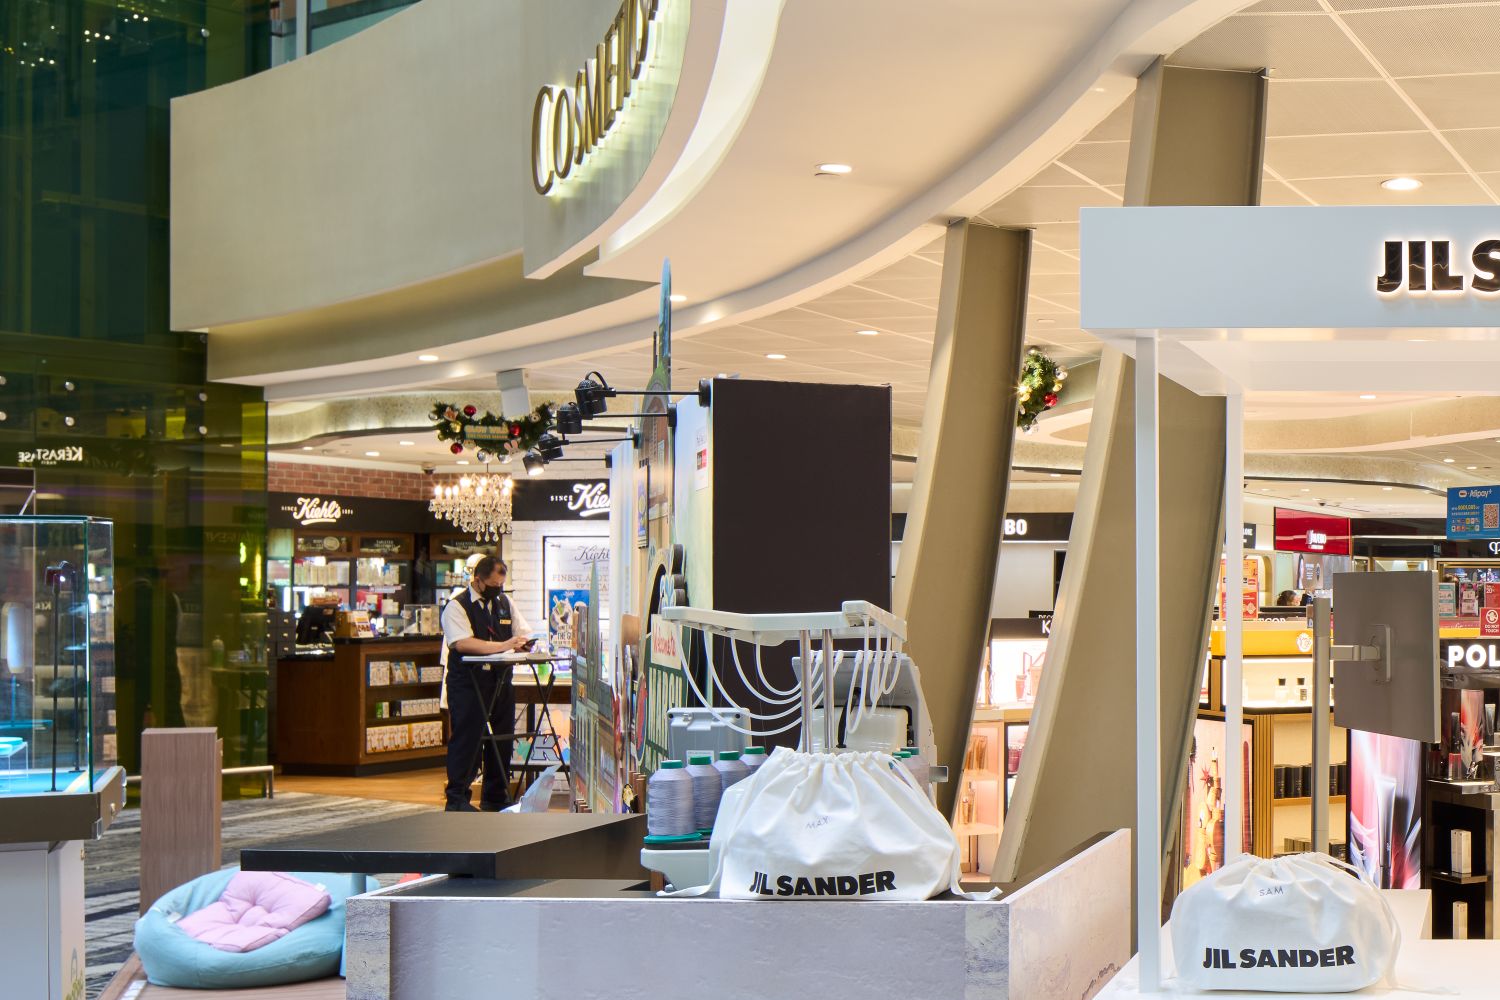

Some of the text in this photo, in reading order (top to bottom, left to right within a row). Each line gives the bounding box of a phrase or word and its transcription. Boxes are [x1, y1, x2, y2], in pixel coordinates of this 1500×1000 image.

[1377, 239, 1464, 293] JIL
[568, 482, 610, 511] Kie
[1004, 518, 1028, 536] BO
[748, 870, 897, 897] JIL SANDER
[1259, 885, 1285, 897] SAM
[1202, 945, 1356, 969] JIL SANDER
